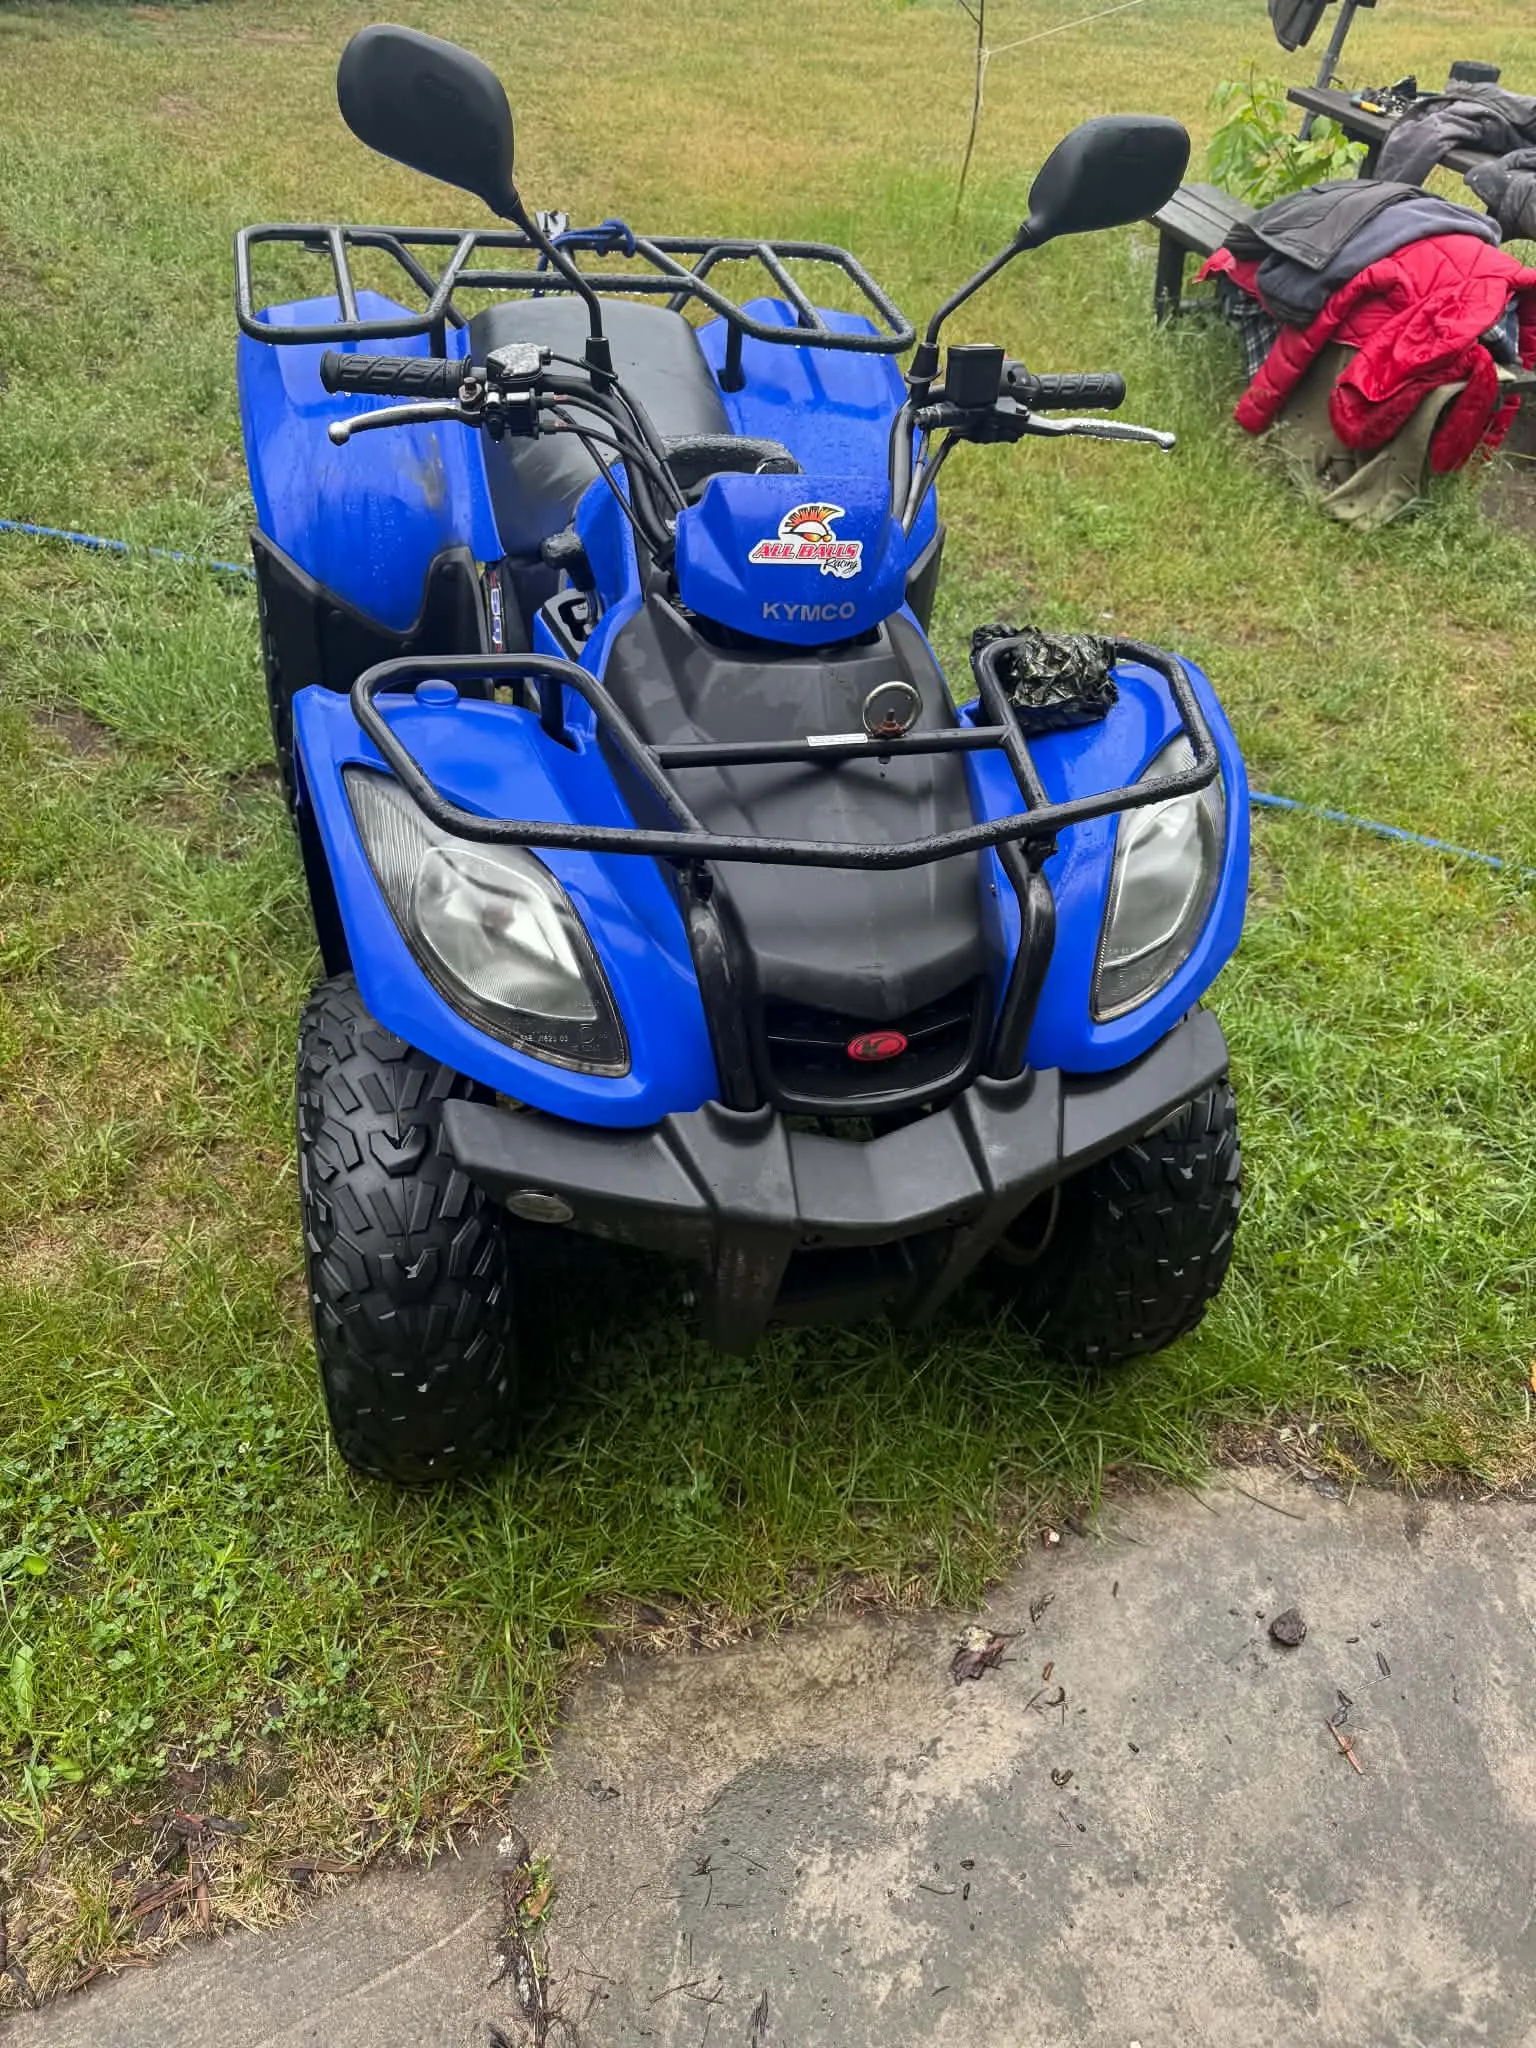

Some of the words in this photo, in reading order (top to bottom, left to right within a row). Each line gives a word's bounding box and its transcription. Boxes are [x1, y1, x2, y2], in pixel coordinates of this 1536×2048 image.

[752, 543, 795, 558] ALL
[796, 543, 860, 560] BALLS
[822, 558, 859, 575] Racing
[762, 601, 856, 621] KYMCO
